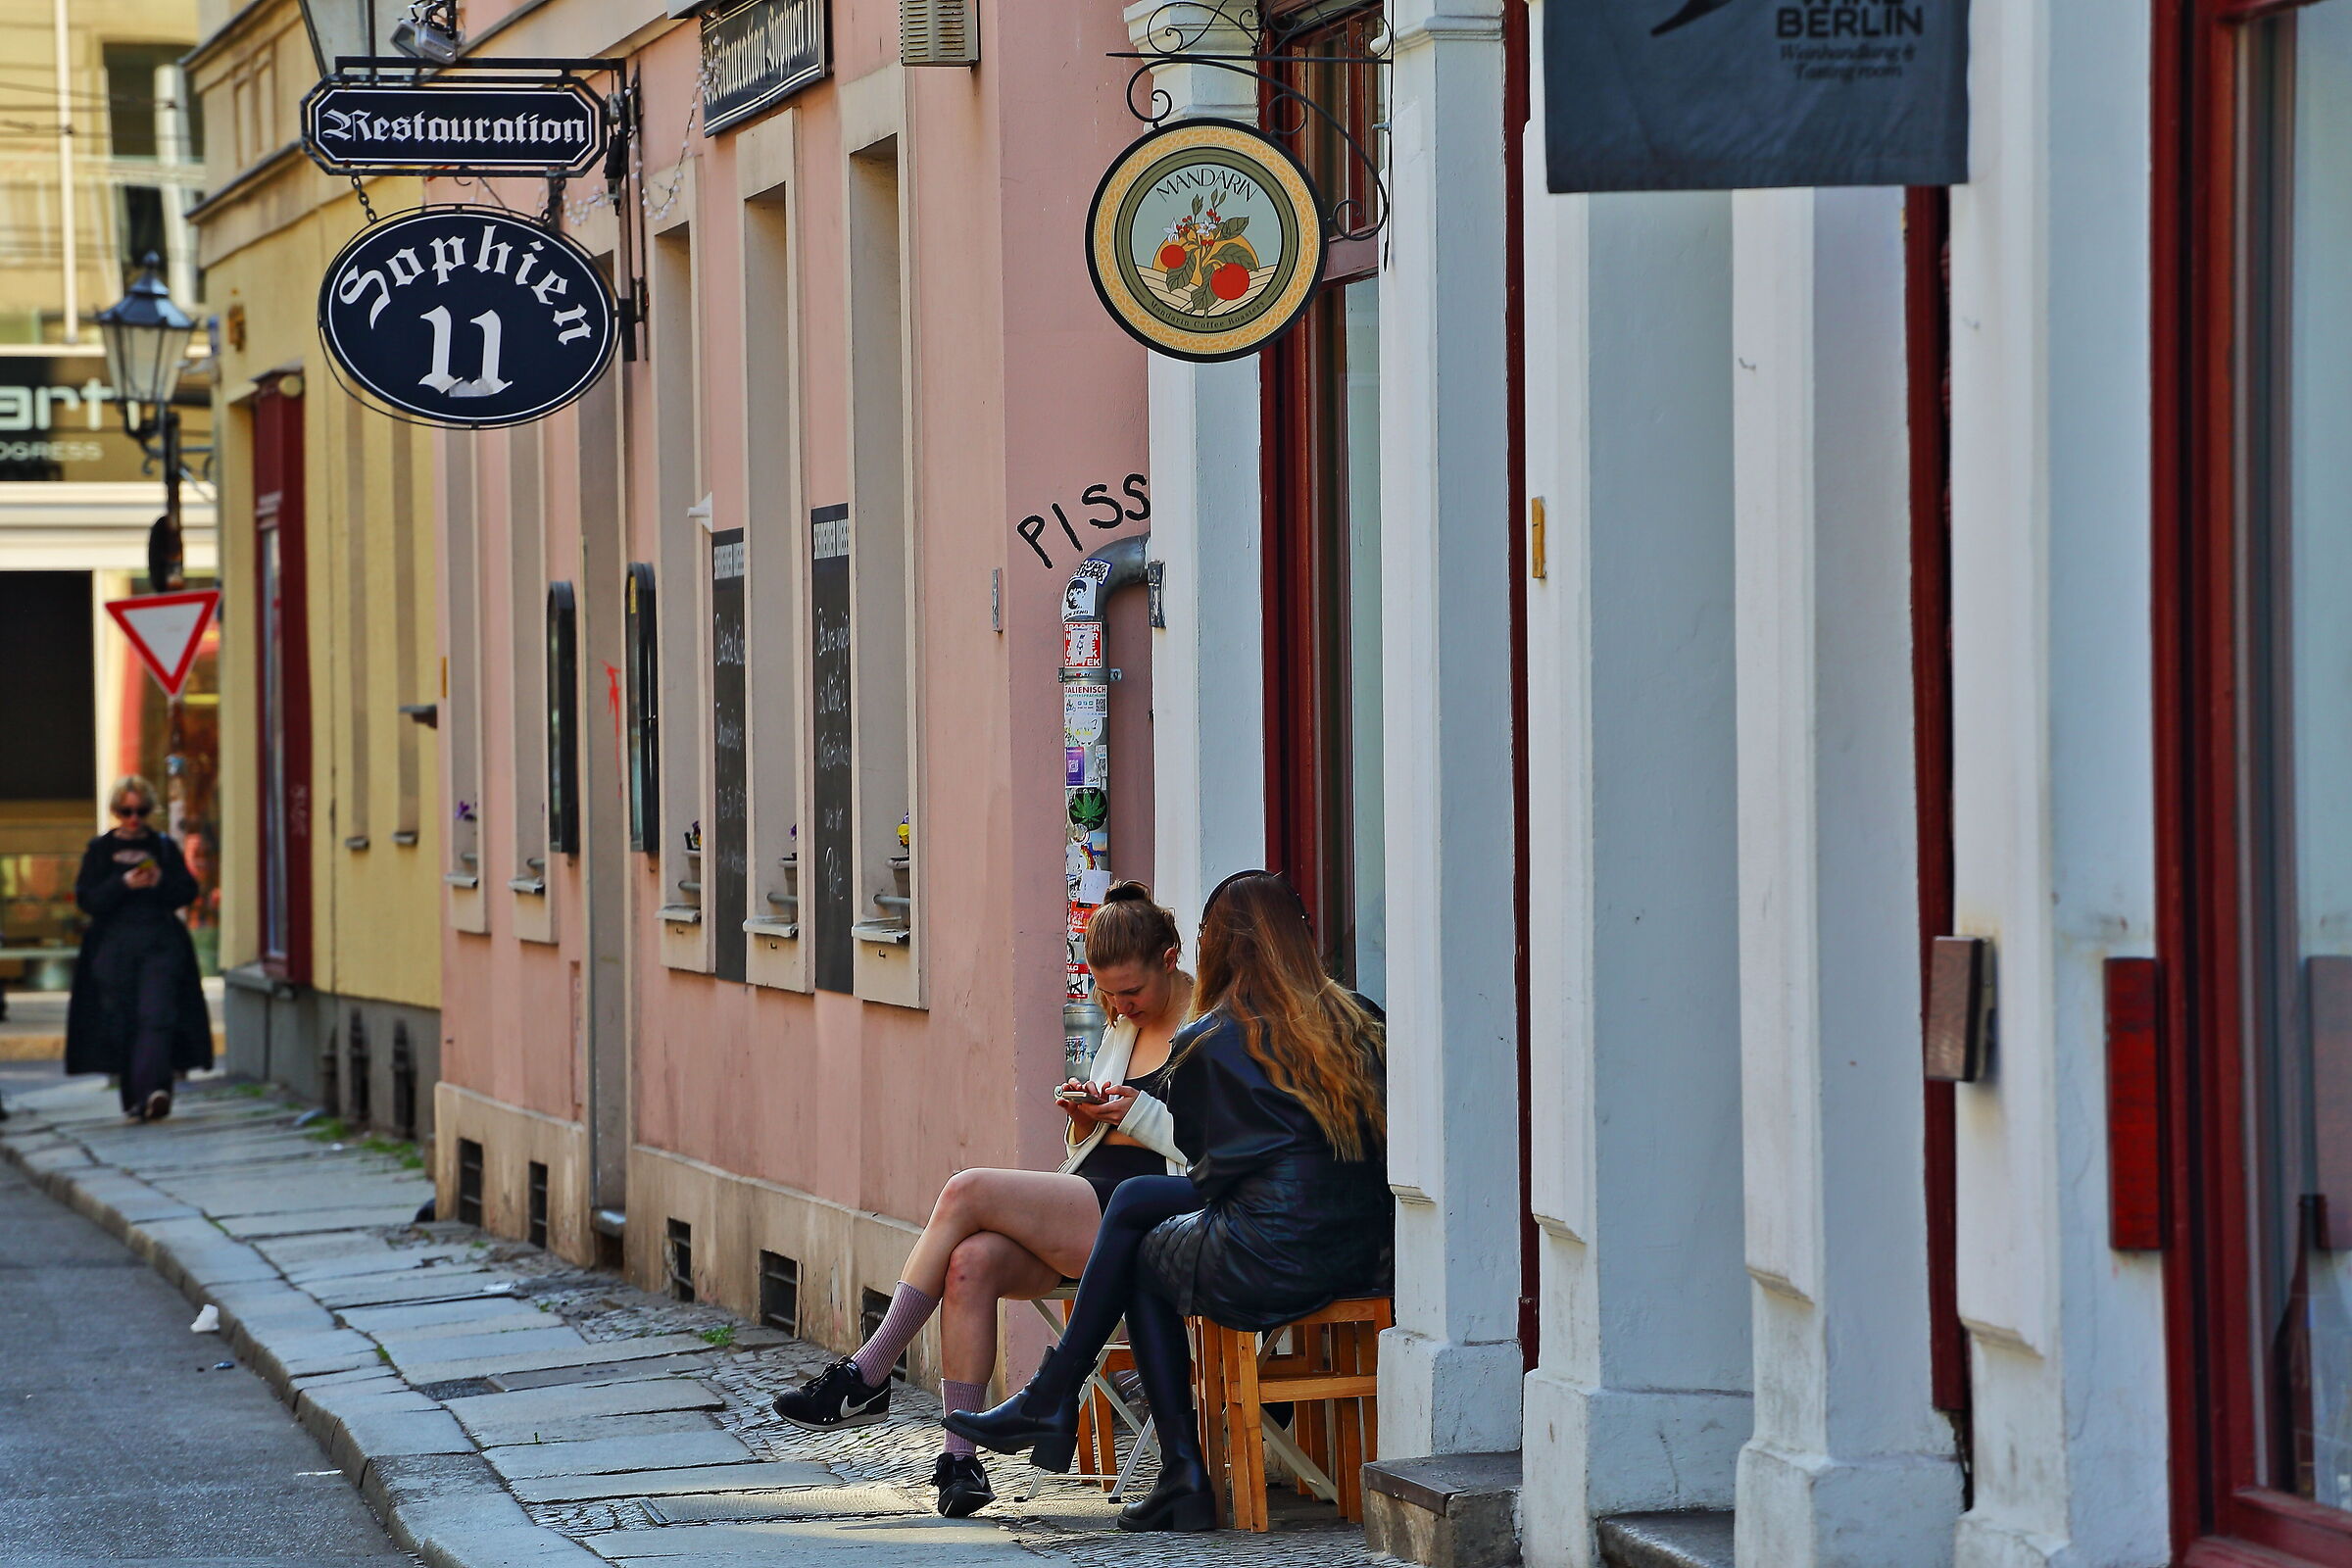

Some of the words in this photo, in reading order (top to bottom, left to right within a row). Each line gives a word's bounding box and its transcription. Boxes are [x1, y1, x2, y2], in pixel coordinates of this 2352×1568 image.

[1776, 6, 1924, 37] BERLIN
[320, 108, 586, 144] Restauration
[1156, 169, 1258, 203] MANDARIN
[338, 224, 591, 345] Sophien
[1151, 300, 1190, 326] Mandarin
[1194, 319, 1225, 328] Coffee
[417, 305, 514, 394] 11
[1016, 473, 1151, 569] PISS
